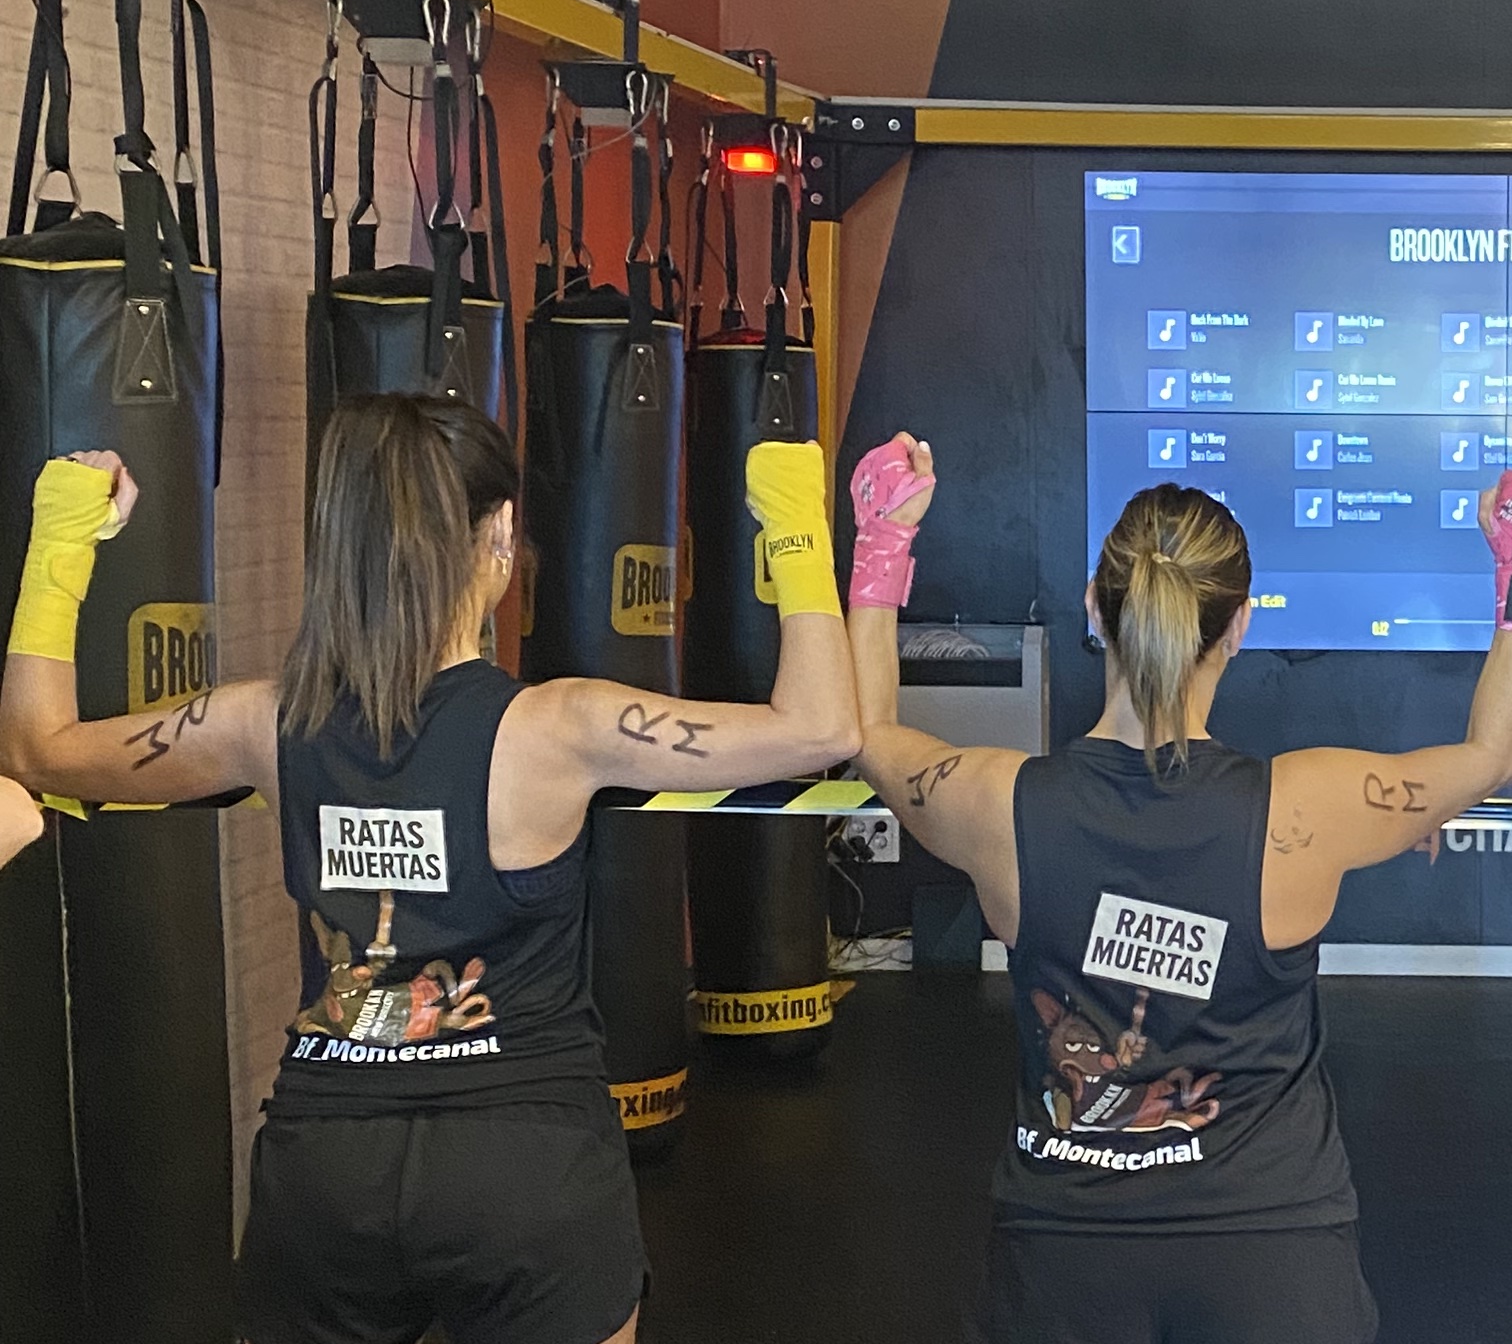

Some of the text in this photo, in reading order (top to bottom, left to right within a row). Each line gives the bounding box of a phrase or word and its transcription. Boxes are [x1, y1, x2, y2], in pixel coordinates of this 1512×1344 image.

[1390, 229, 1494, 262] BROOKLYN
[769, 533, 814, 558] BROOKLYN
[339, 817, 425, 849] RATAS
[327, 848, 441, 881] MUERTAS
[1115, 908, 1206, 953] RATAS
[1090, 936, 1212, 986] MUERTAS
[1017, 1126, 1204, 1171] Bf_Montecanal
